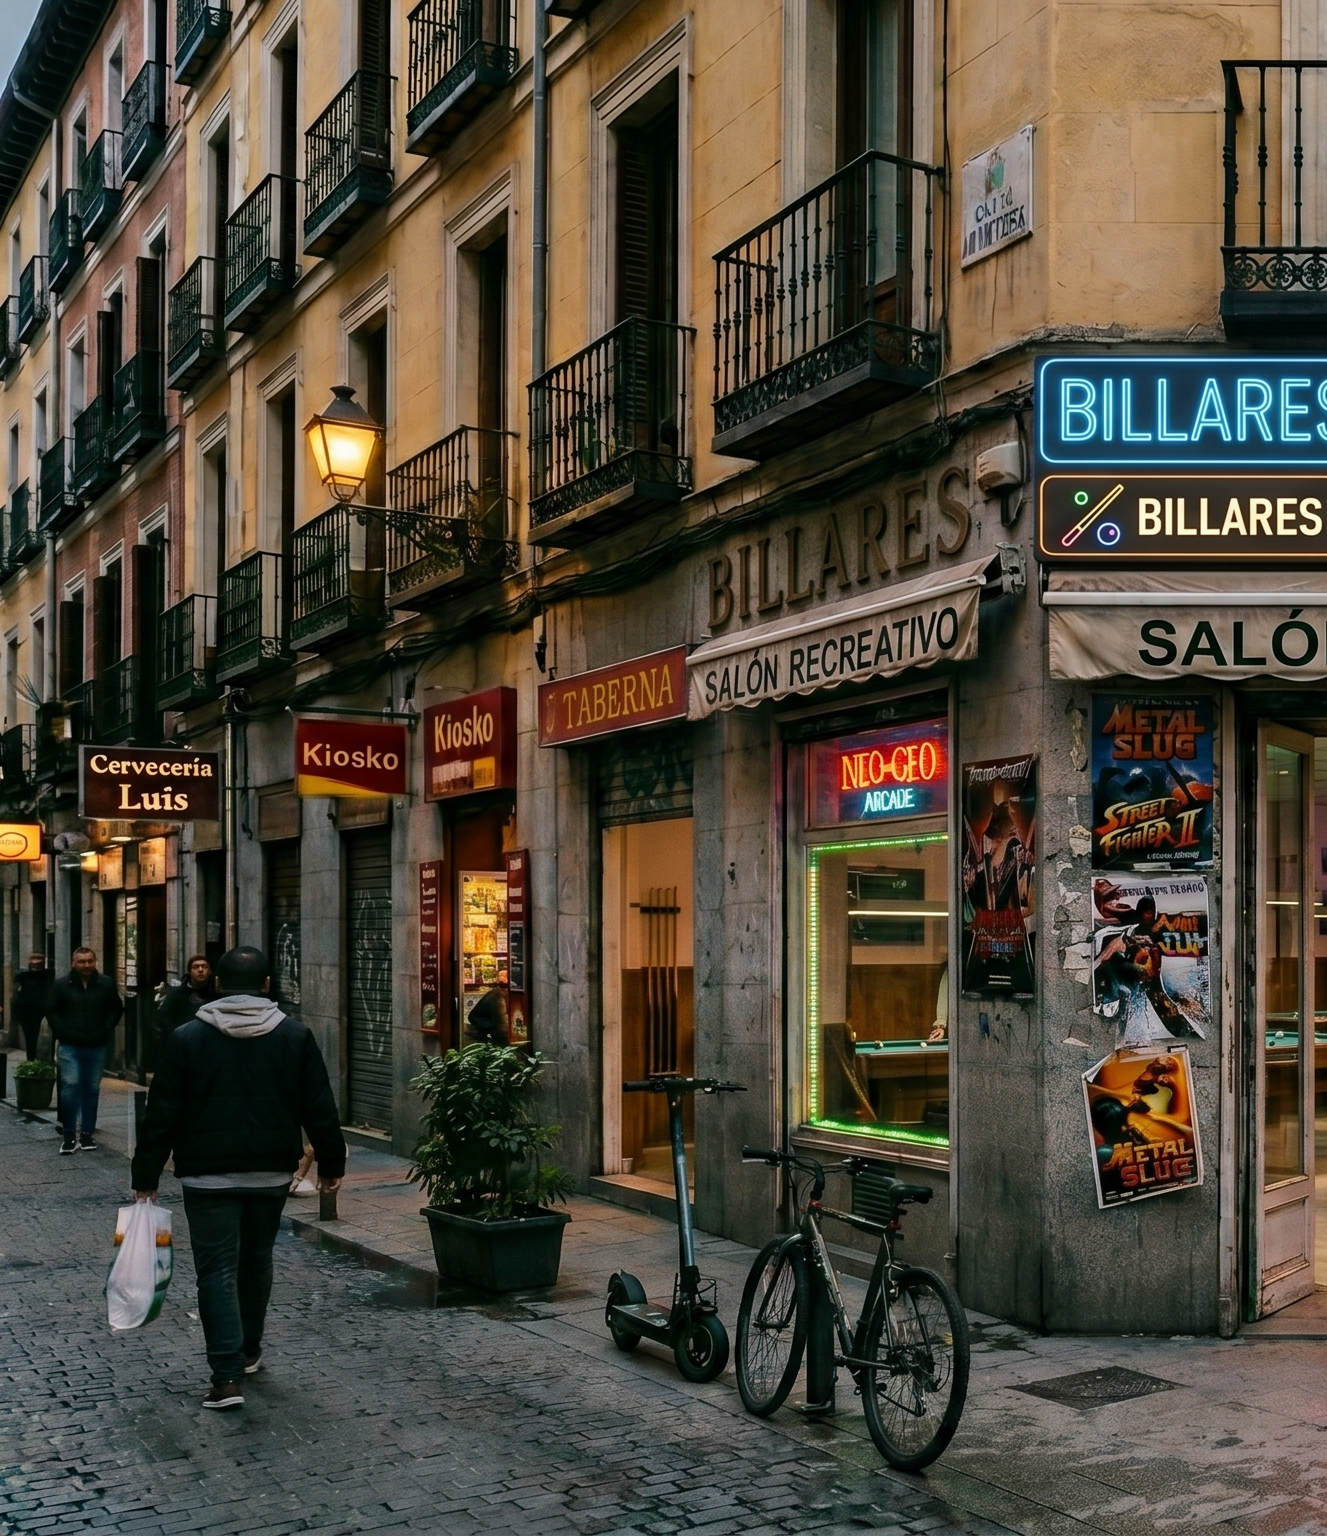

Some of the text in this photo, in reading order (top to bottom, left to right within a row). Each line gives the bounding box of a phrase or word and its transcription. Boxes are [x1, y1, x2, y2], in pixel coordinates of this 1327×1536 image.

[1137, 496, 1324, 536] BILLARES
[707, 465, 972, 629] BILLARES
[705, 606, 959, 706] SALÓN RECREATIVO
[563, 664, 674, 730] TABERNA
[434, 705, 494, 753] Kiosko
[1102, 703, 1206, 733] METAL
[303, 742, 399, 770] Kiosko
[1113, 733, 1198, 761] SLUG
[90, 754, 213, 777] Cervecería
[864, 788, 915, 812] ARCADE
[1095, 798, 1178, 835] STREET
[1100, 807, 1204, 857] FIGHTER II
[1102, 1139, 1194, 1171] METAL
[1121, 1156, 1194, 1187] SLUG
